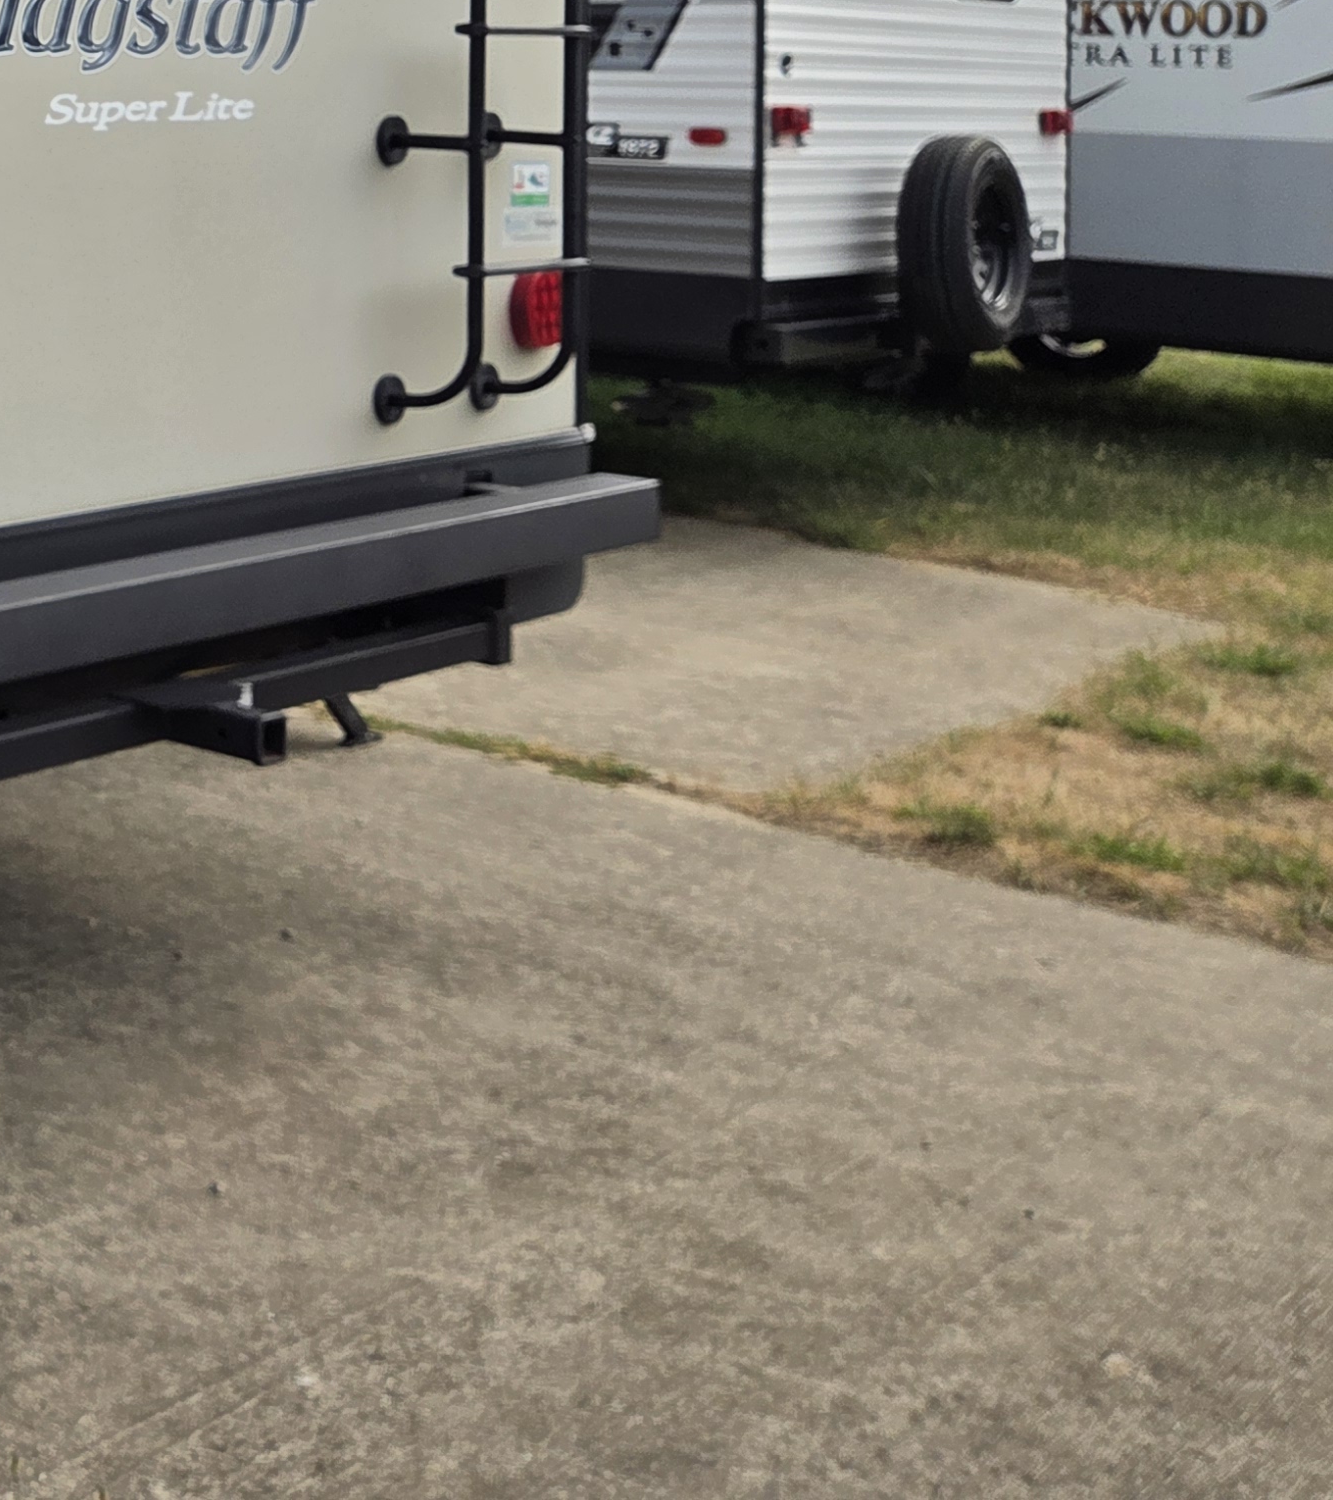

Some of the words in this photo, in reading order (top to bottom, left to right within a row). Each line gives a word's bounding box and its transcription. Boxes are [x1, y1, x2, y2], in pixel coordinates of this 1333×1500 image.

[1149, 43, 1233, 69] LITE
[44, 93, 165, 132] Super
[167, 91, 255, 124] Lite
